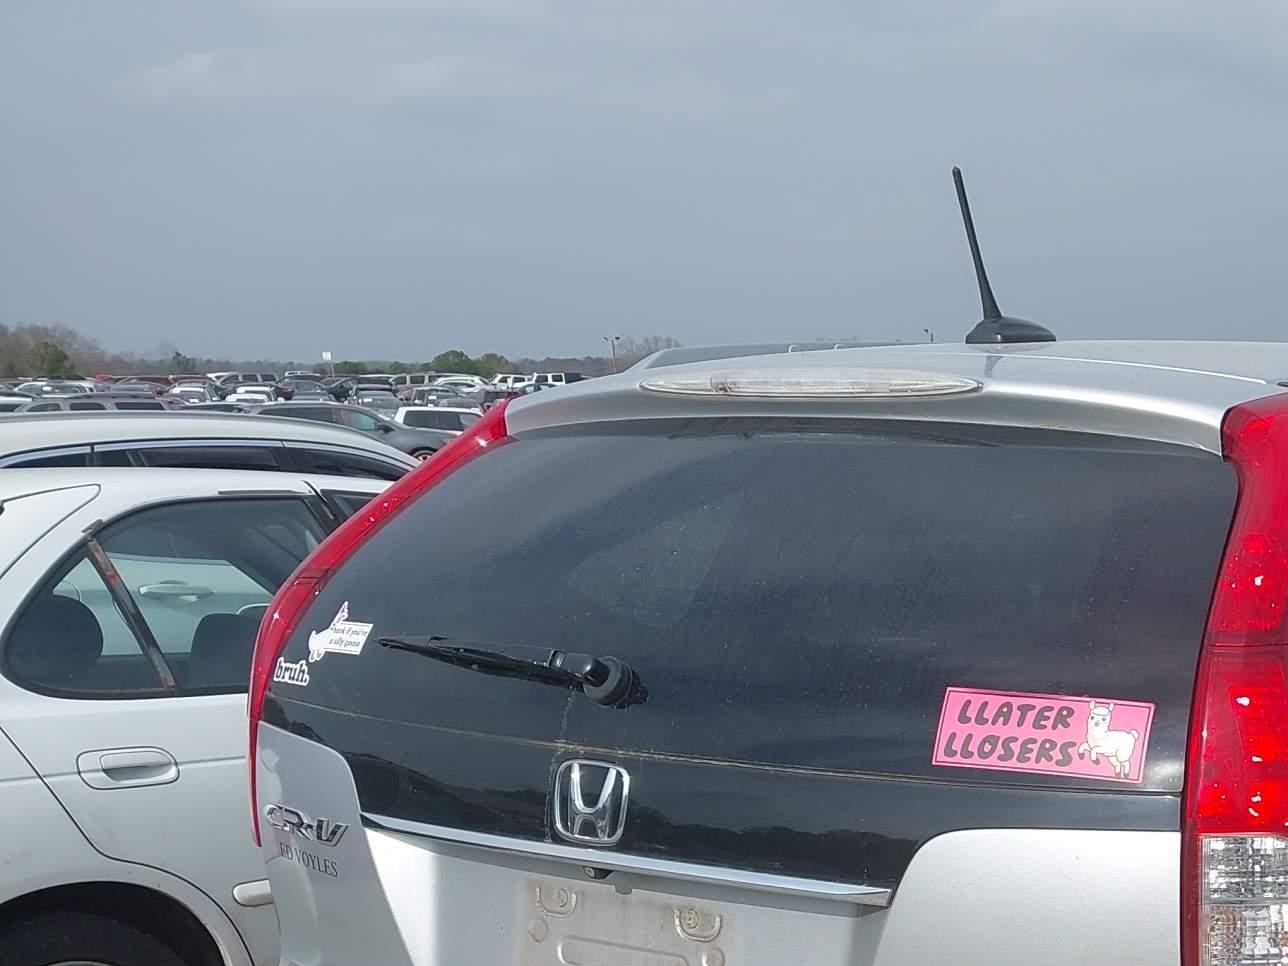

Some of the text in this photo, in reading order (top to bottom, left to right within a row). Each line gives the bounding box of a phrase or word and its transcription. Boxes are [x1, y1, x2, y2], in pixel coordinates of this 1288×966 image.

[343, 640, 361, 648] goose
[275, 659, 308, 684] bruh.
[957, 699, 1076, 731] LLATER
[943, 731, 1077, 767] LLOSERS
[263, 802, 351, 848] CR-V
[280, 842, 339, 878] ED VOYLES
